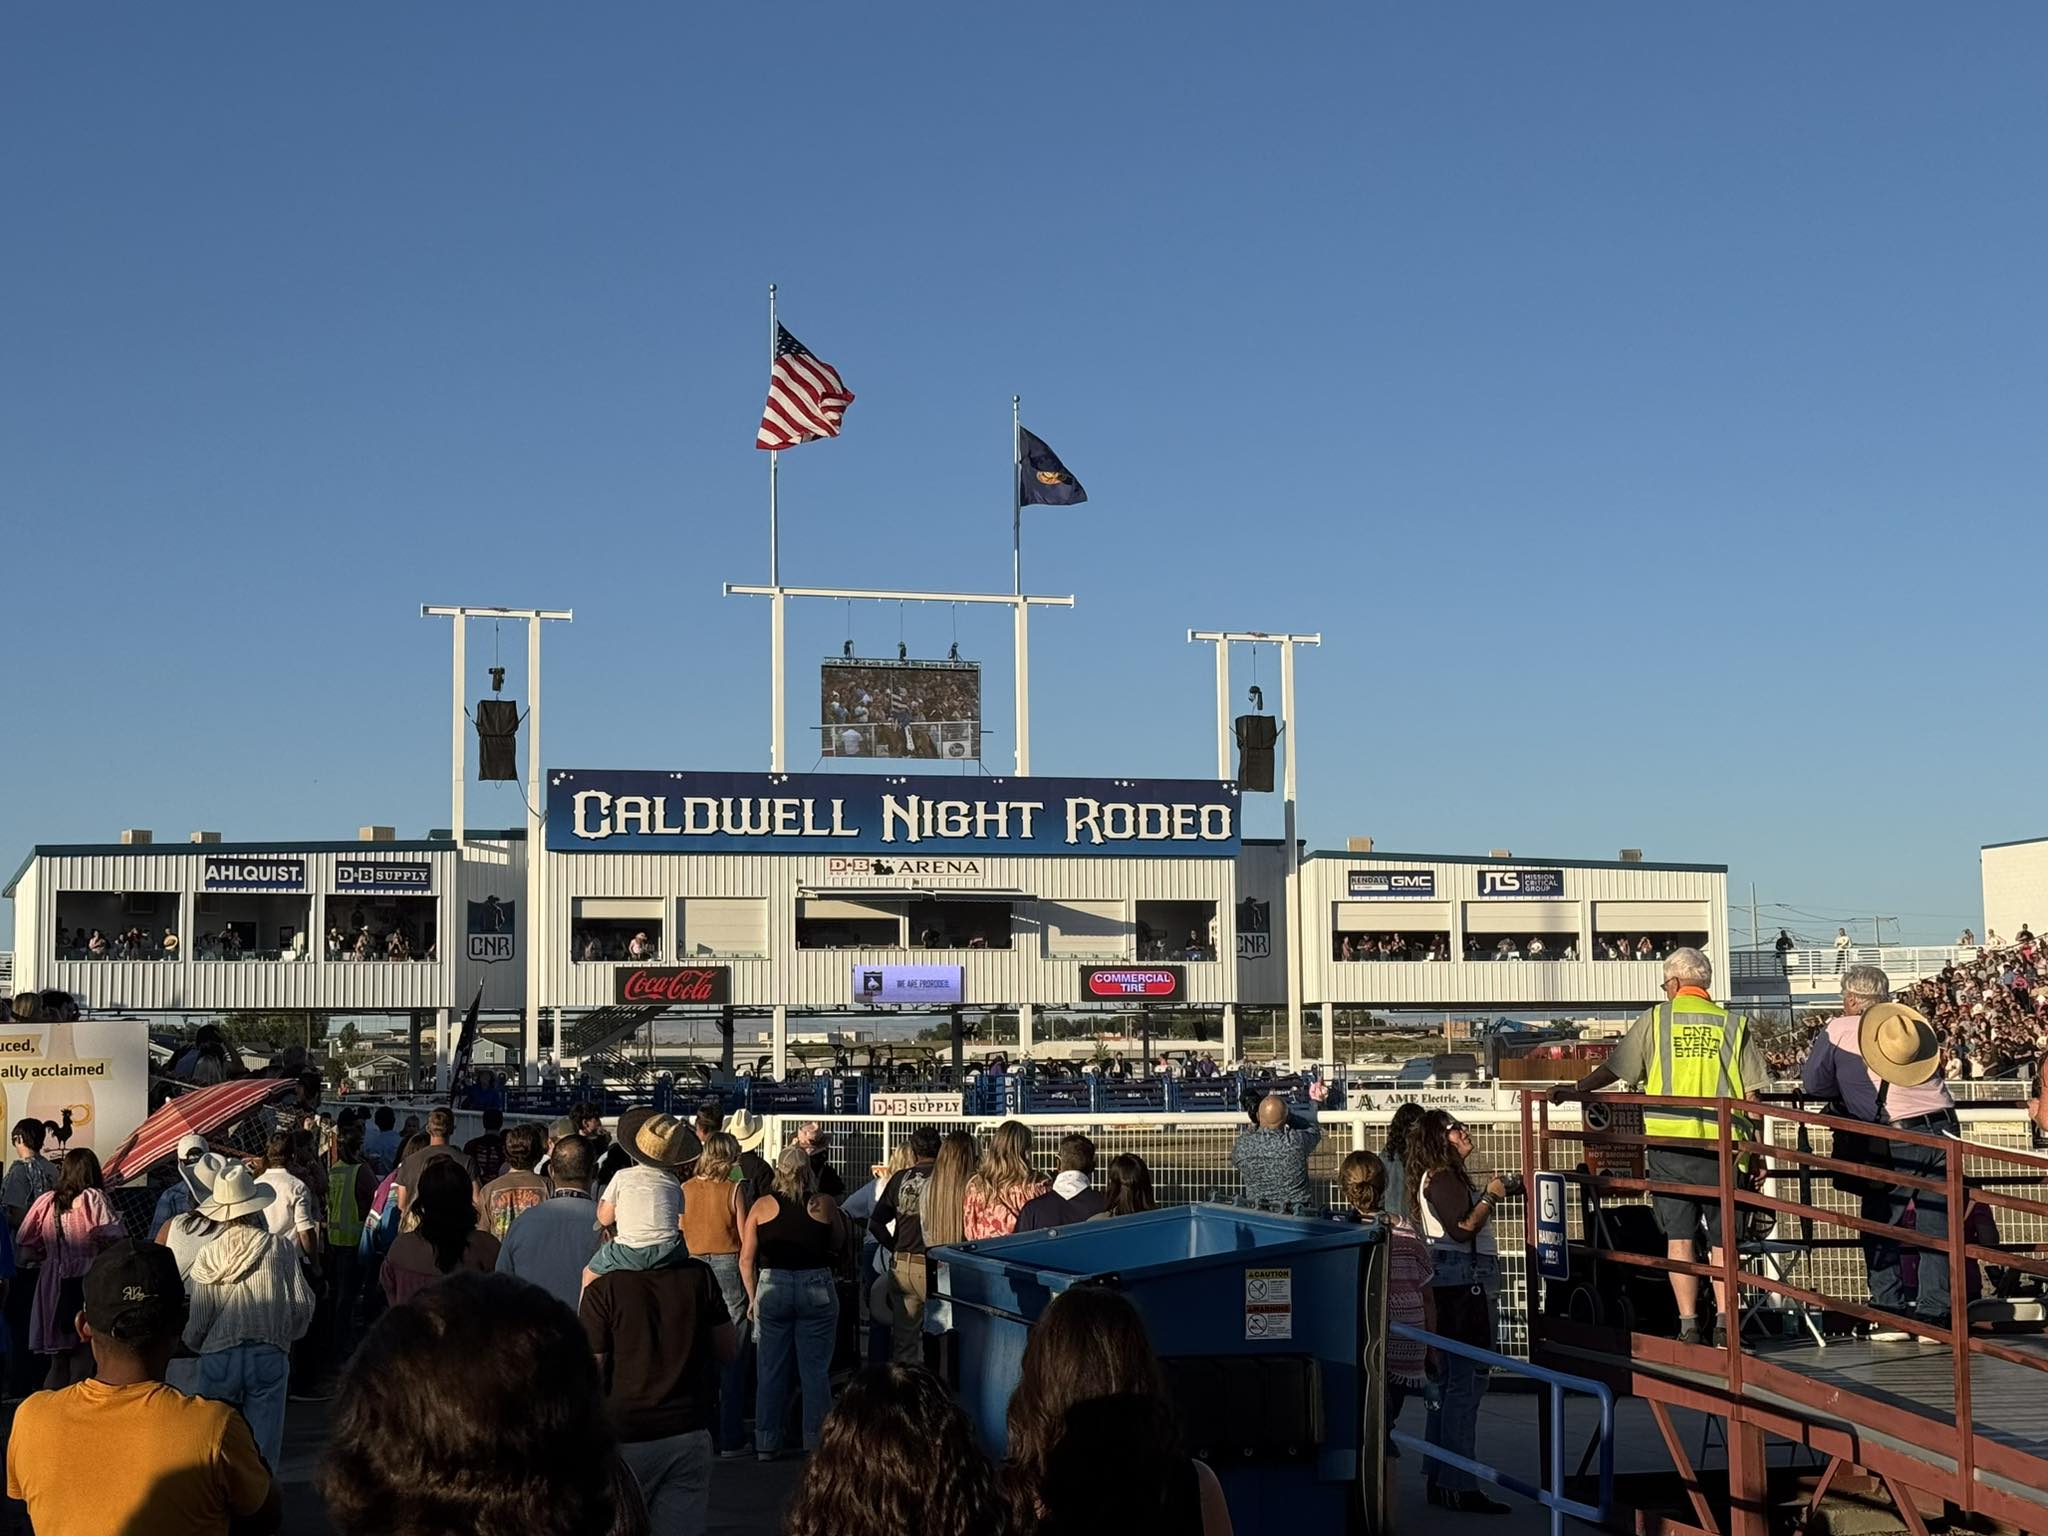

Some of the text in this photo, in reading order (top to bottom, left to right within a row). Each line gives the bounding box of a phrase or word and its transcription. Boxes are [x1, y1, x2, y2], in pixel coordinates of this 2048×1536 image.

[571, 789, 1234, 845] CALDWELL NIGHT RODEO
[899, 860, 980, 873] ARENA
[205, 865, 302, 881] AHLQUIST.
[376, 870, 428, 881] SUPPLY
[1351, 875, 1431, 886] KENDALL GMC
[471, 936, 511, 956] CNR
[1095, 973, 1170, 983] COMMERCIAL
[1120, 983, 1146, 992] TIRE
[1683, 1026, 1712, 1037] CNR
[1673, 1037, 1720, 1049] EVENT
[1675, 1047, 1718, 1059] STAFF
[1, 1063, 104, 1080] ally acclaimed
[1385, 1093, 1418, 1104] AME
[1422, 1093, 1459, 1104] Electric,
[1464, 1095, 1485, 1104] Inc.
[909, 1102, 960, 1113] SUPPLY
[1611, 1111, 1640, 1125] FREE
[1538, 1229, 1564, 1247] HANDICAP
[1254, 1270, 1289, 1278] CAUTION
